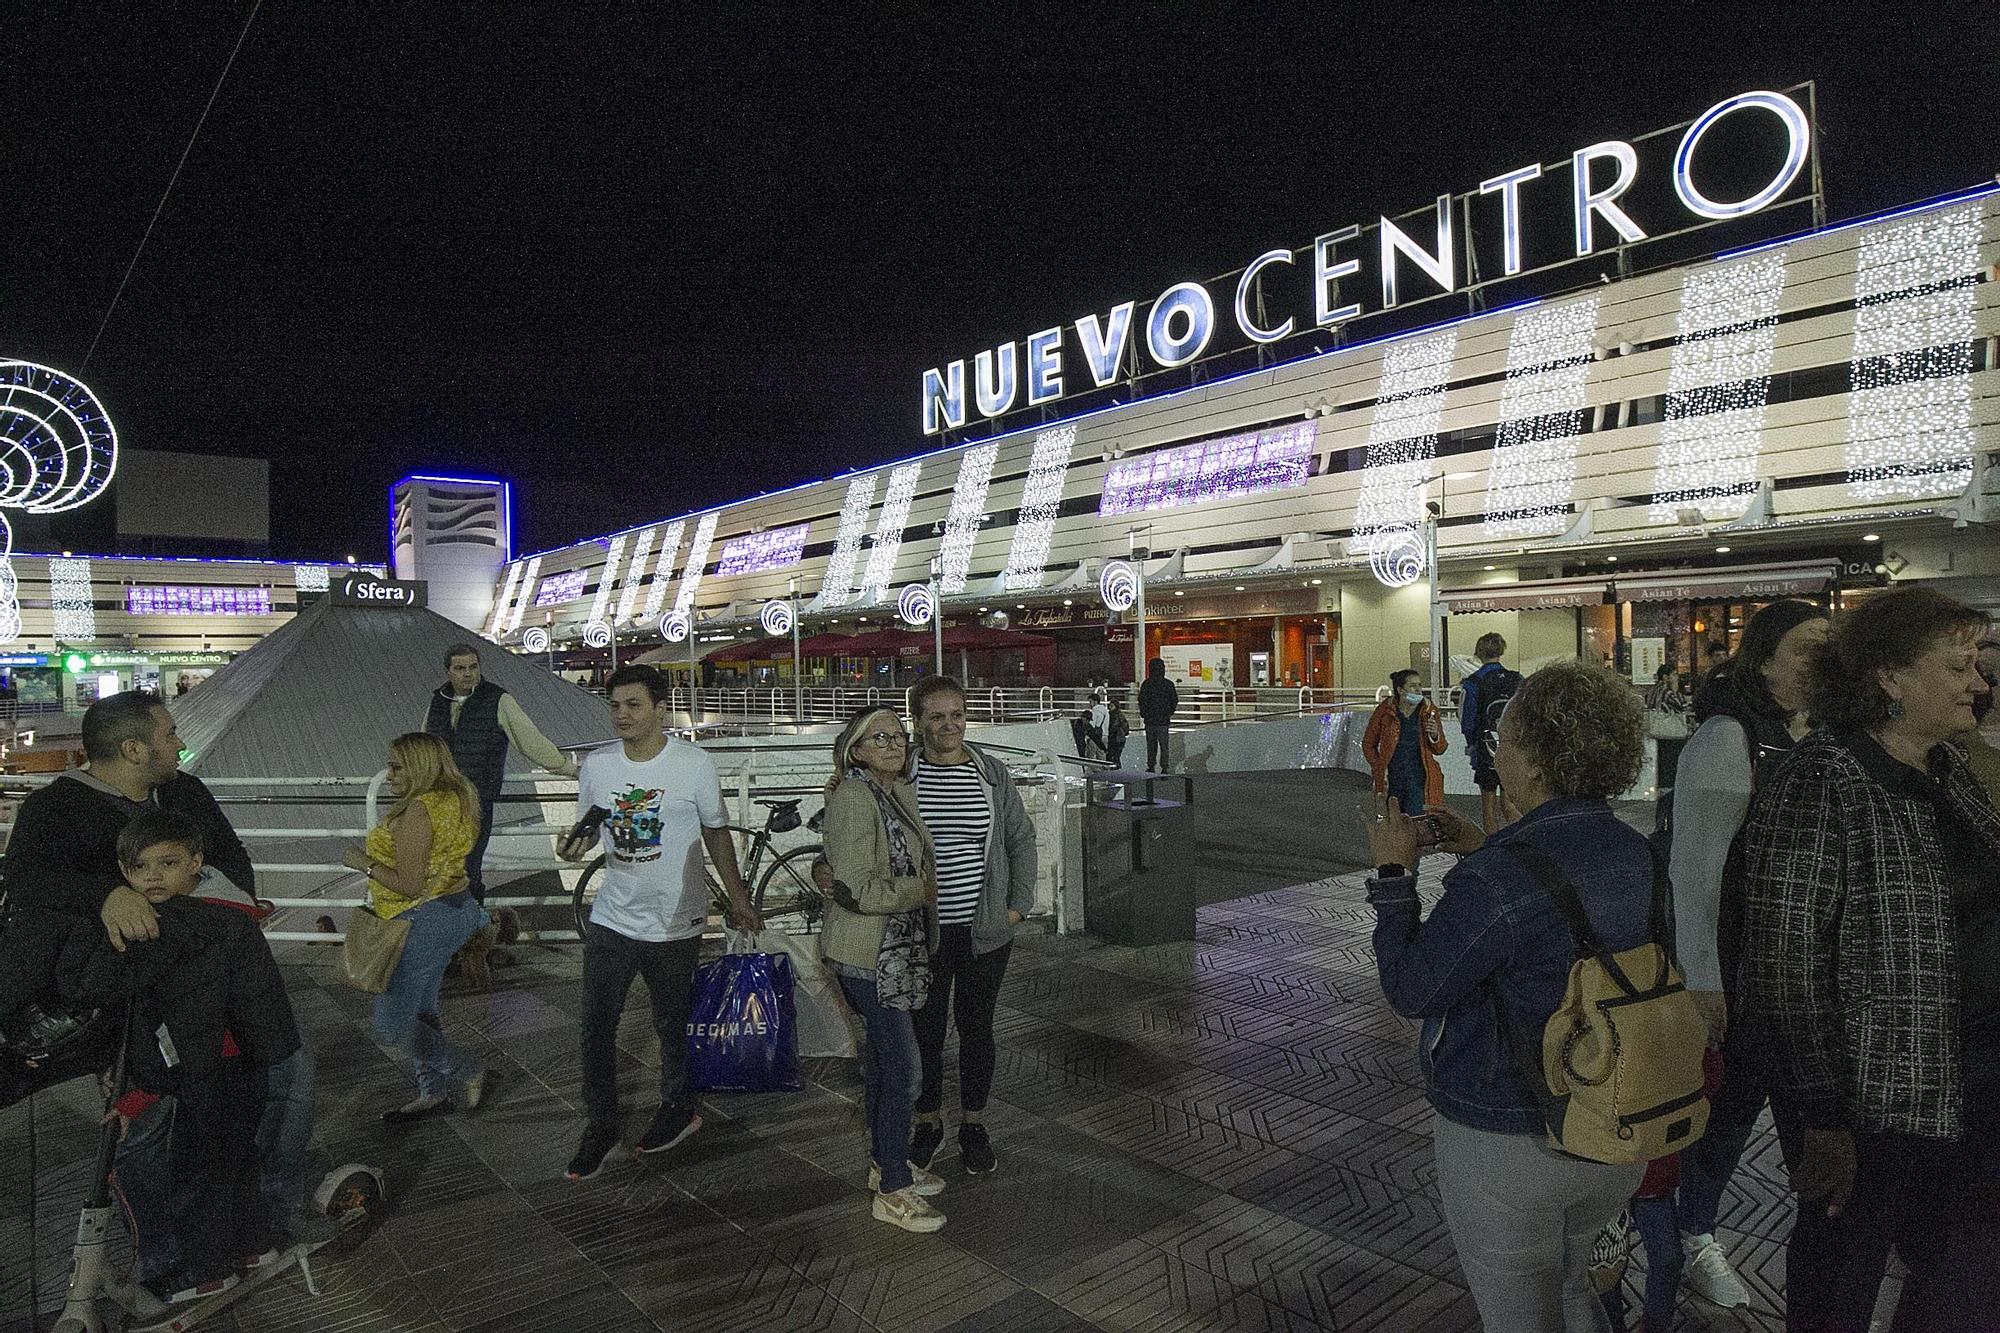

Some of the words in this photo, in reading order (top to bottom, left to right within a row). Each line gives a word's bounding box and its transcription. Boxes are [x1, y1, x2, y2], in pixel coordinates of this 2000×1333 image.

[1743, 583, 1779, 593] Asian
[1641, 589, 1673, 599] Asian
[1455, 600, 1481, 609] Asian
[1538, 596, 1566, 606] Asian
[1018, 609, 1032, 626] La
[160, 655, 188, 663] NUEVO
[190, 655, 221, 663] CENTRO
